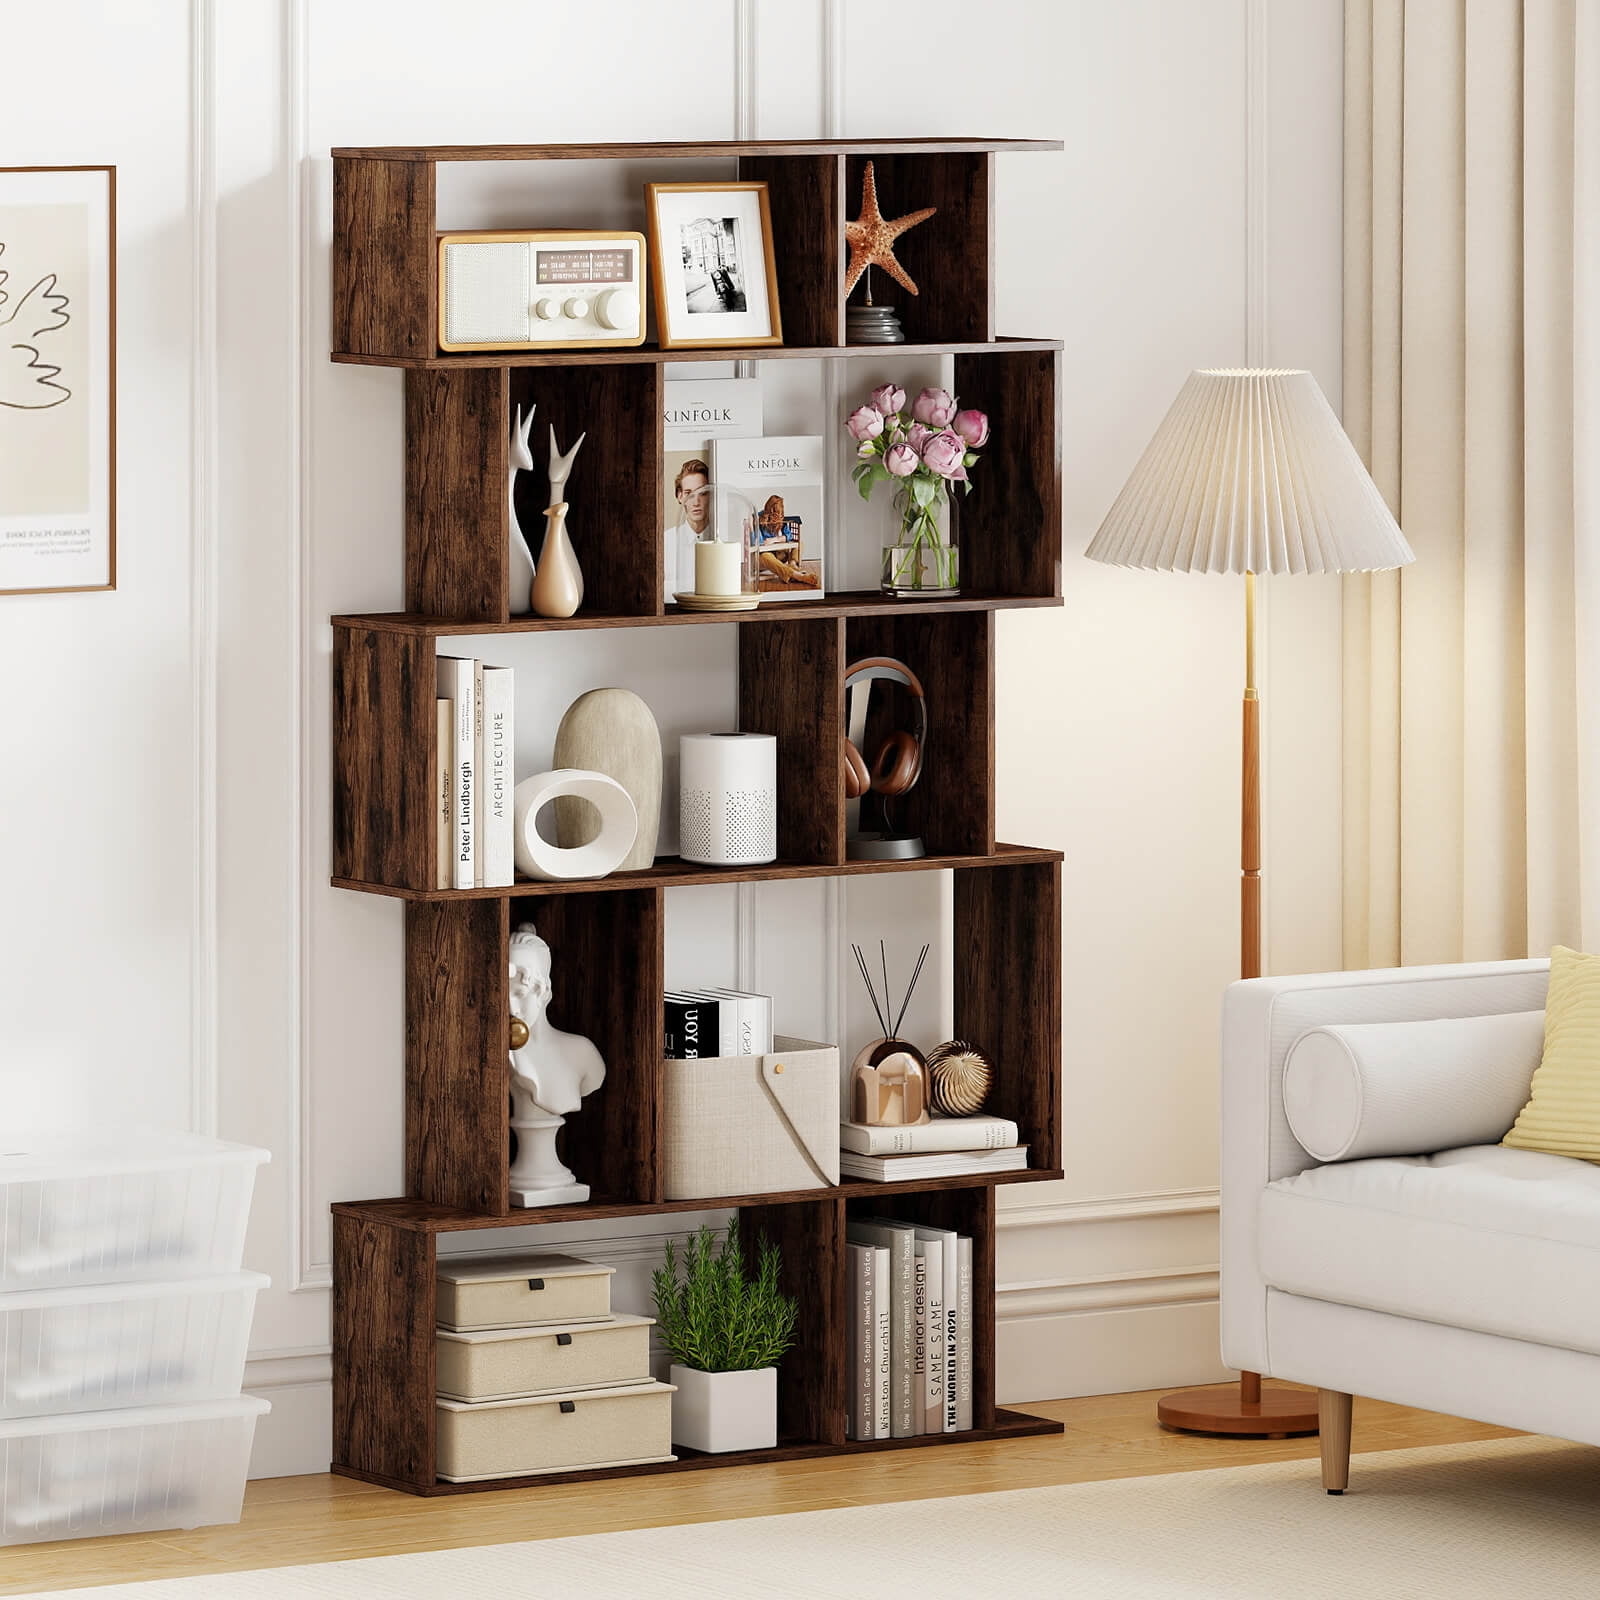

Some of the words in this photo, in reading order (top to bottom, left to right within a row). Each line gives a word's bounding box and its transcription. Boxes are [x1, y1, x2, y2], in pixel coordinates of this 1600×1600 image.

[663, 409, 731, 422] KINFOLK
[748, 458, 799, 469] KINFOLK
[494, 712, 503, 817] ARCHITECTURE
[461, 761, 472, 825] Lindbergh
[461, 829, 470, 862] Peter
[903, 1234, 911, 1260] house
[863, 1252, 871, 1276] Voice
[903, 1265, 911, 1279] the
[903, 1284, 911, 1294] in
[914, 1263, 925, 1315] design
[863, 1290, 871, 1325] Hawking
[931, 1300, 941, 1343] SAME
[903, 1300, 911, 1354] arrangement
[948, 1310, 956, 1341] 2020
[863, 1328, 871, 1363] Stephen
[880, 1311, 889, 1373] Churchill
[914, 1320, 924, 1375] Interior
[948, 1345, 956, 1356] IN
[863, 1367, 871, 1387] Gave
[904, 1358, 911, 1369] an
[931, 1353, 941, 1396] SAME
[961, 1336, 970, 1401] HOUSEHOLD
[903, 1374, 911, 1394] make
[948, 1360, 956, 1403] WORLD
[863, 1392, 871, 1416] Intel
[880, 1380, 889, 1430] Winston
[903, 1399, 911, 1409] to
[948, 1406, 956, 1427] THE
[903, 1413, 911, 1429] How
